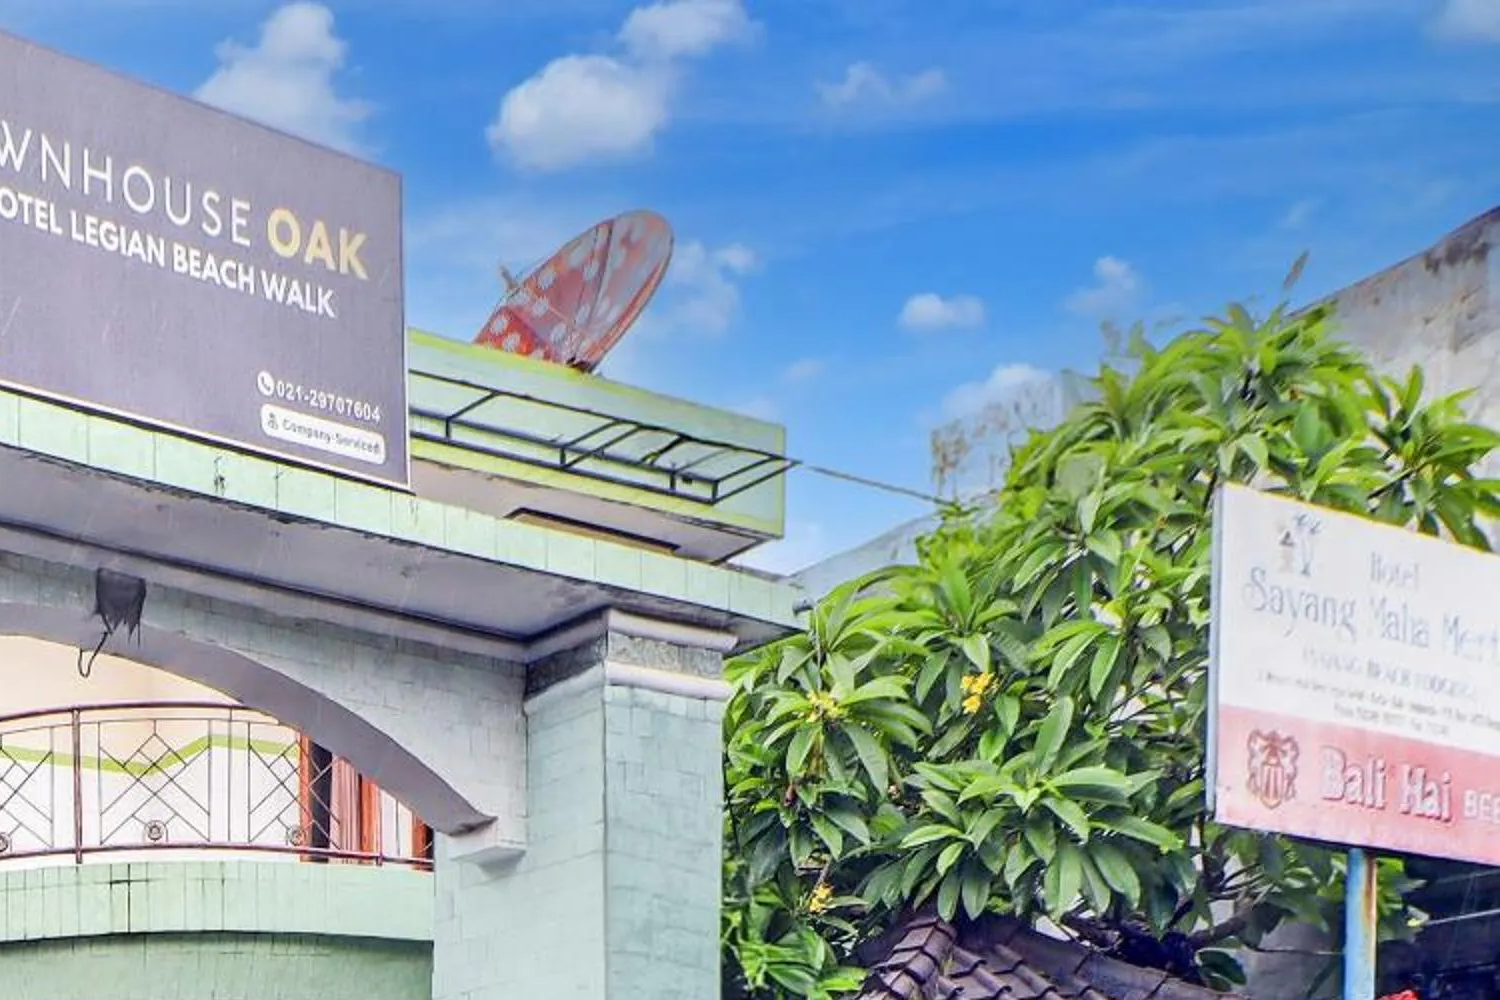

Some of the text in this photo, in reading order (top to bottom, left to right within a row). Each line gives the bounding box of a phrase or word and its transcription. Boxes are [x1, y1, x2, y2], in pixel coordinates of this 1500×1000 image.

[70, 209, 166, 268] LEGIAN
[172, 242, 255, 294] BEACH
[260, 268, 336, 318] WALK
[266, 207, 368, 280] OAK
[275, 380, 381, 424] 021-29707604
[1242, 566, 1357, 645] Sayang
[1370, 551, 1420, 591] Hotel
[1320, 745, 1387, 811] Bali
[1400, 763, 1452, 824] Hai
